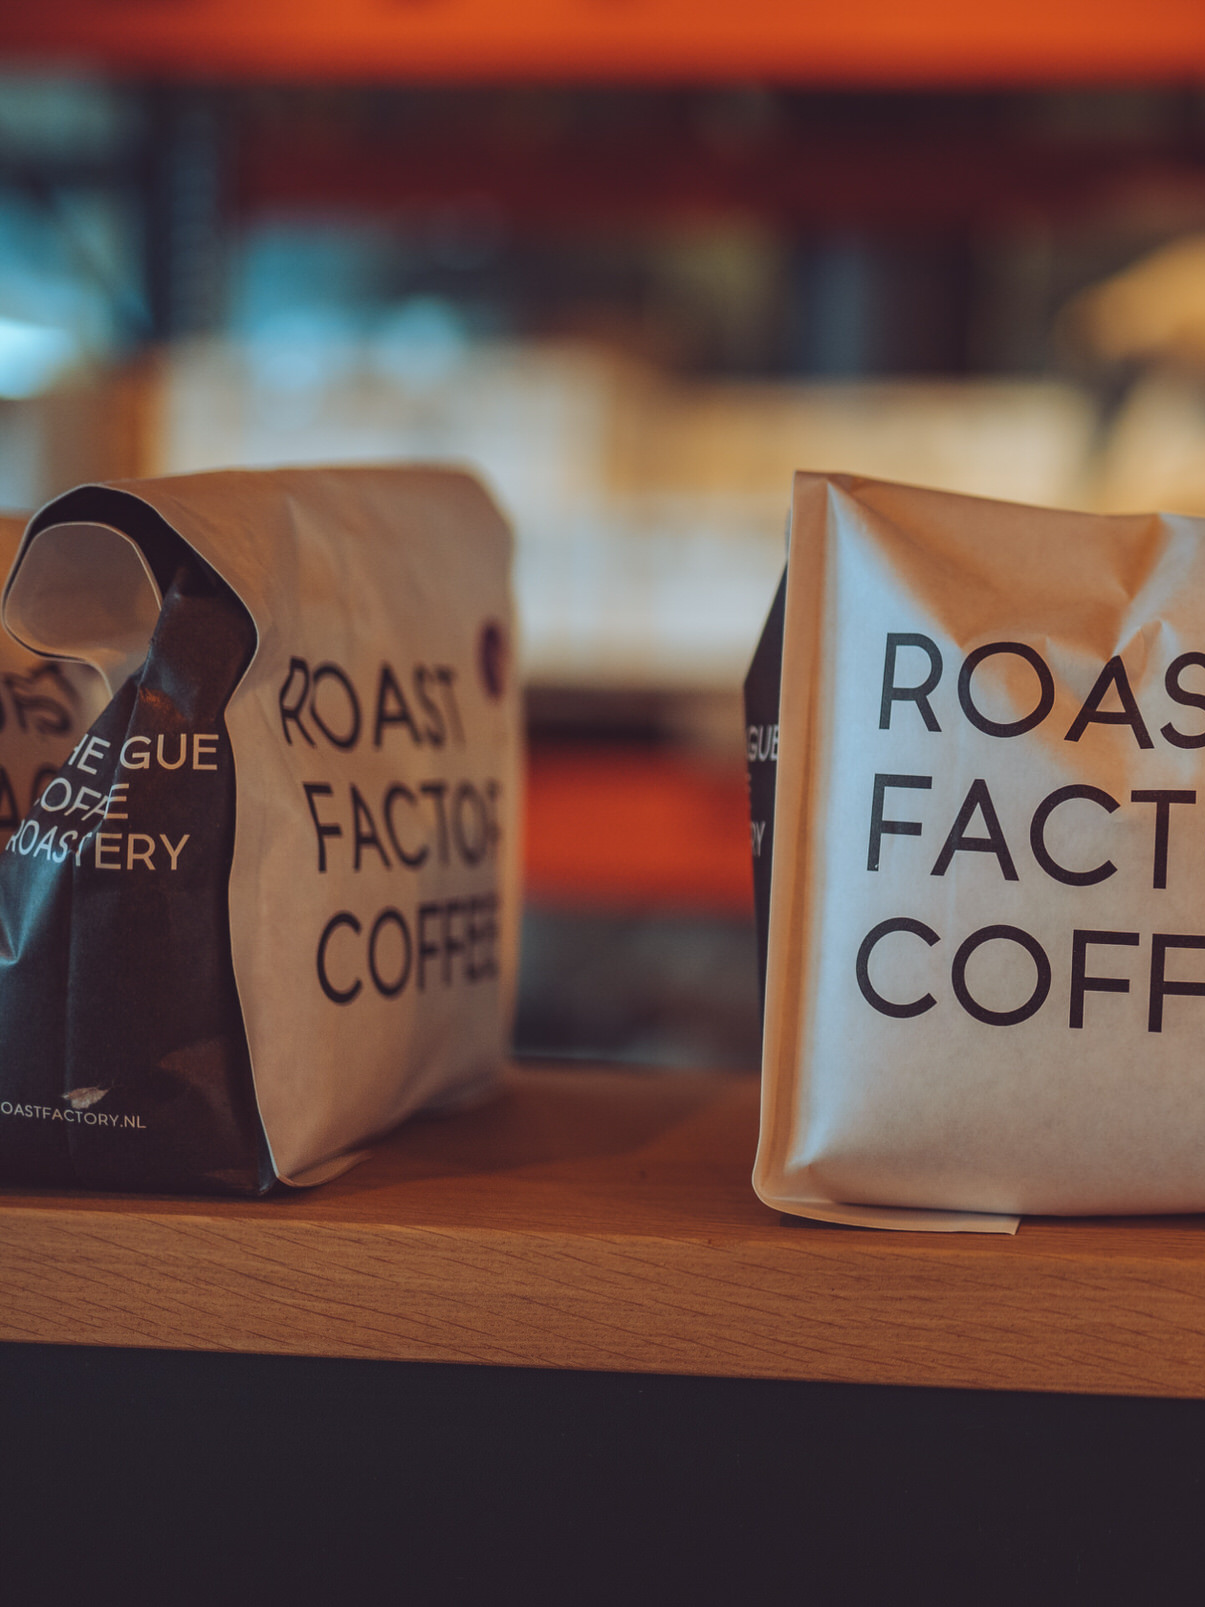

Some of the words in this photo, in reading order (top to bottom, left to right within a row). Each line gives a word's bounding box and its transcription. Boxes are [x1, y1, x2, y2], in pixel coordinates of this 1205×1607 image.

[278, 655, 467, 753] ROAST
[119, 733, 220, 771] GUE
[0, 1101, 147, 1129] OASTFACTORY.NL
